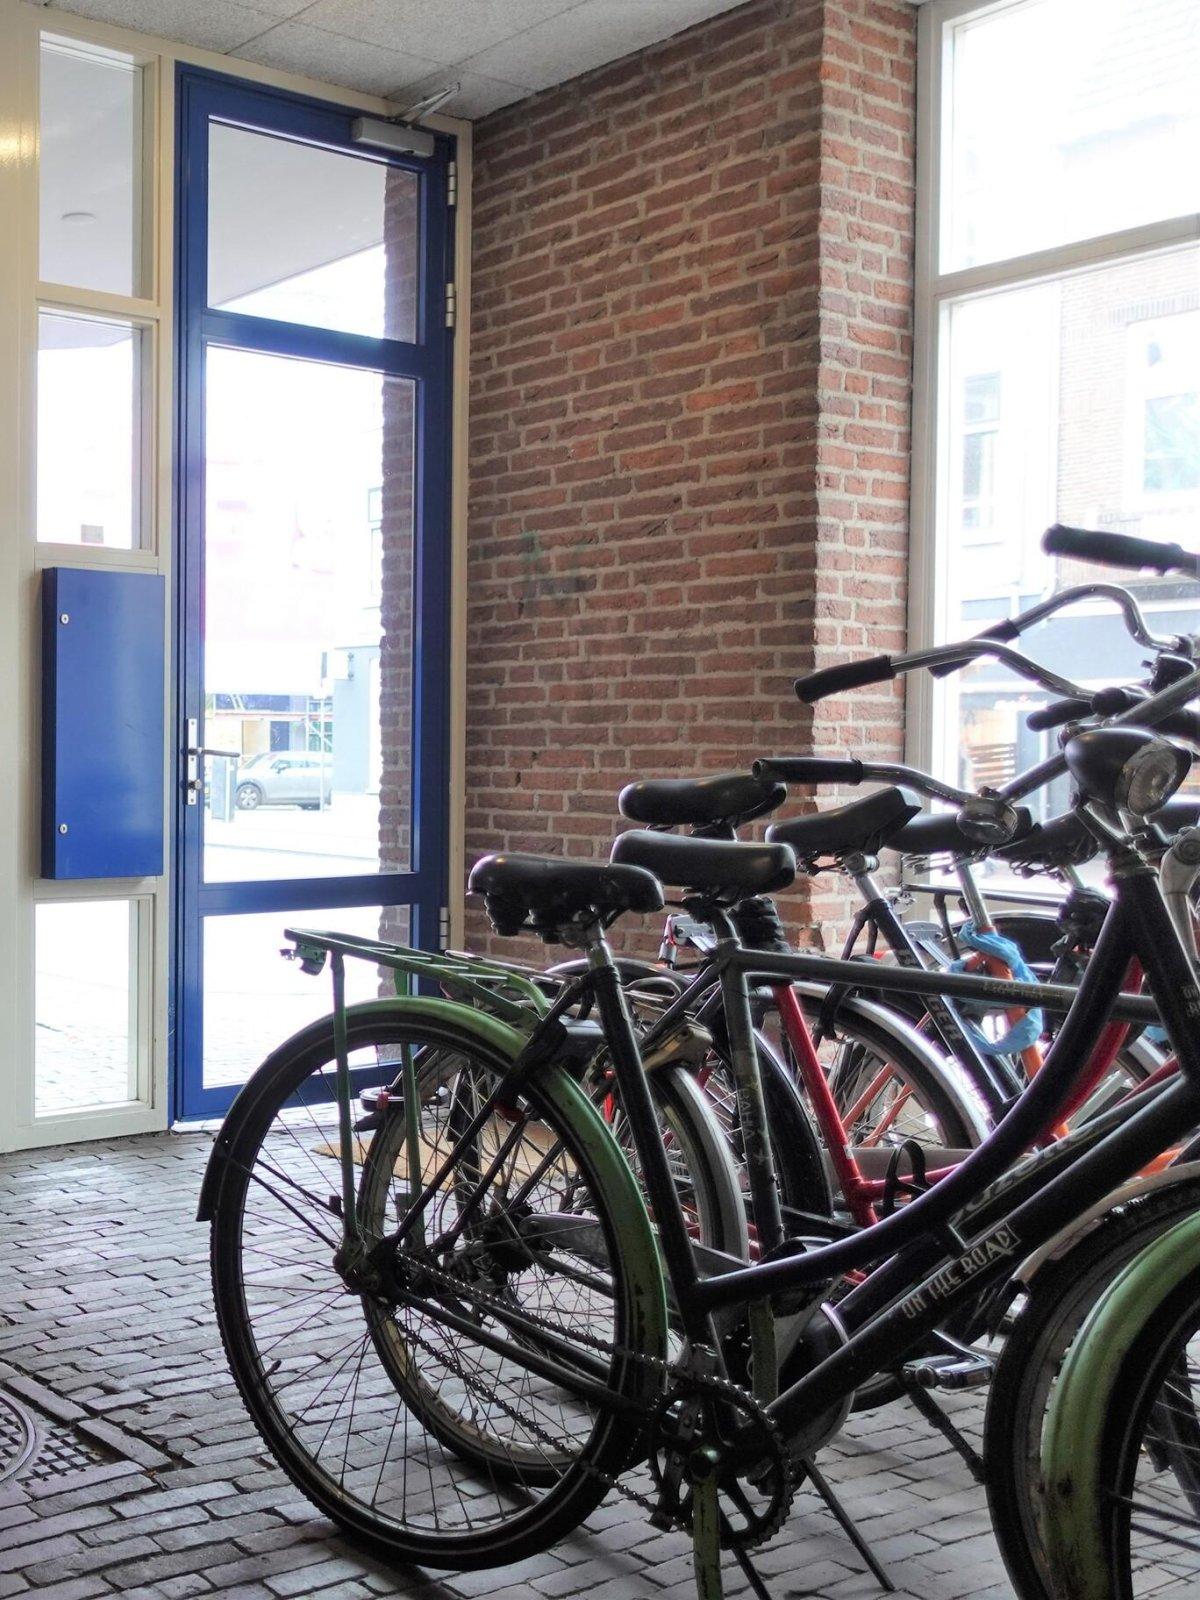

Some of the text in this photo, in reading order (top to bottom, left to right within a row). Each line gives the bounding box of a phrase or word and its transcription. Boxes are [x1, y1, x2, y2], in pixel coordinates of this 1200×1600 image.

[901, 1230, 1015, 1319] ON THE ROAD
